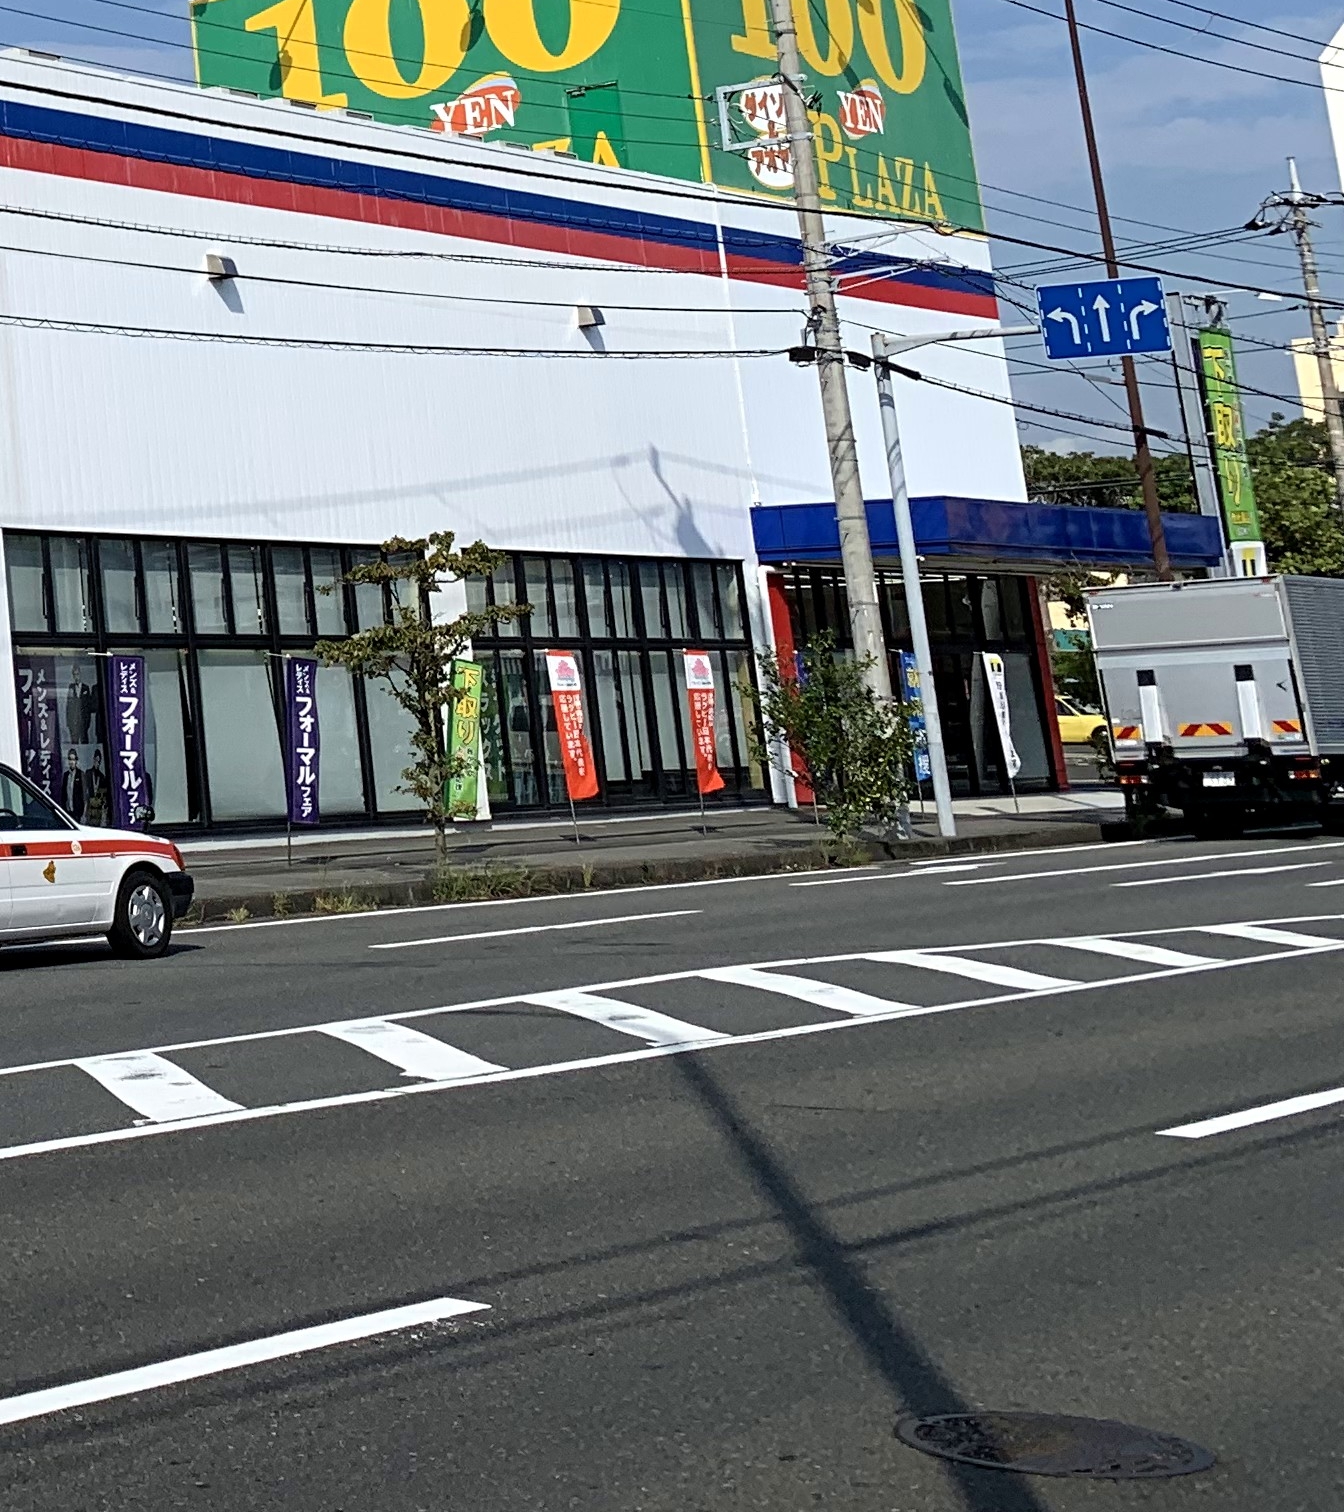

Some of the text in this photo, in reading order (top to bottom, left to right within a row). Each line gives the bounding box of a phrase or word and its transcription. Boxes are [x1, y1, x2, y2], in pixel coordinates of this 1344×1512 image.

[429, 87, 518, 137] YEN
[836, 90, 884, 135] YEN
[807, 110, 947, 220] PLAZA
